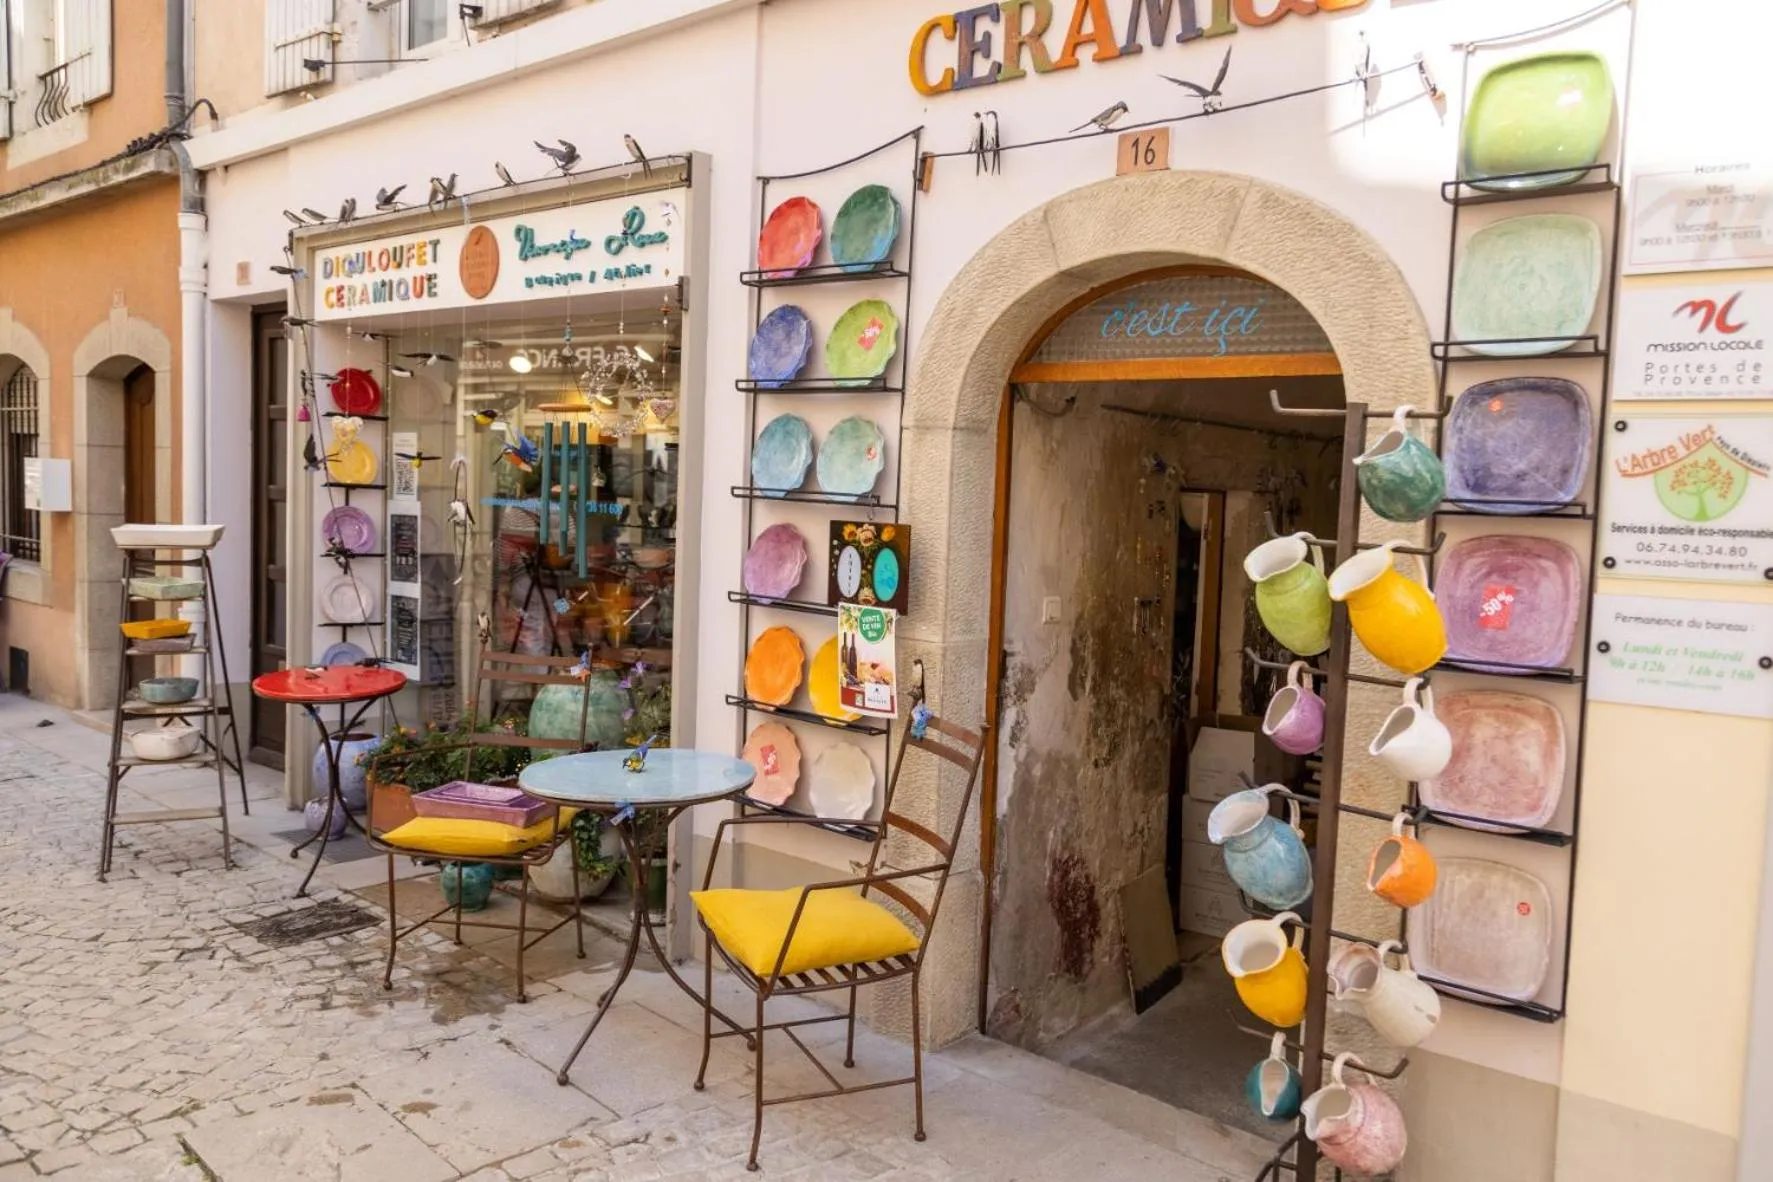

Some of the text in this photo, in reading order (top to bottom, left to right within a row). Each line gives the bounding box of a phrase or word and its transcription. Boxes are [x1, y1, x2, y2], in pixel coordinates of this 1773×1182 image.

[908, 0, 1450, 98] CERAM
[1131, 136, 1155, 165] 16
[324, 273, 438, 309] CERAMIQUE
[1101, 300, 1199, 337] c'est
[1645, 360, 1763, 374] Portes de
[1644, 374, 1761, 385] Provence
[1615, 424, 1715, 473] L'Arbre Vert
[1611, 522, 1648, 534] Services
[1658, 525, 1695, 535] domicile
[1636, 542, 1748, 557] 06.74.94.34.80
[1480, 592, 1514, 616] -50%
[1615, 612, 1683, 628] Permanence
[1687, 618, 1702, 629] du
[1705, 620, 1748, 632] bureau
[1623, 642, 1662, 655] Lundi
[1683, 647, 1744, 662] Vendredi
